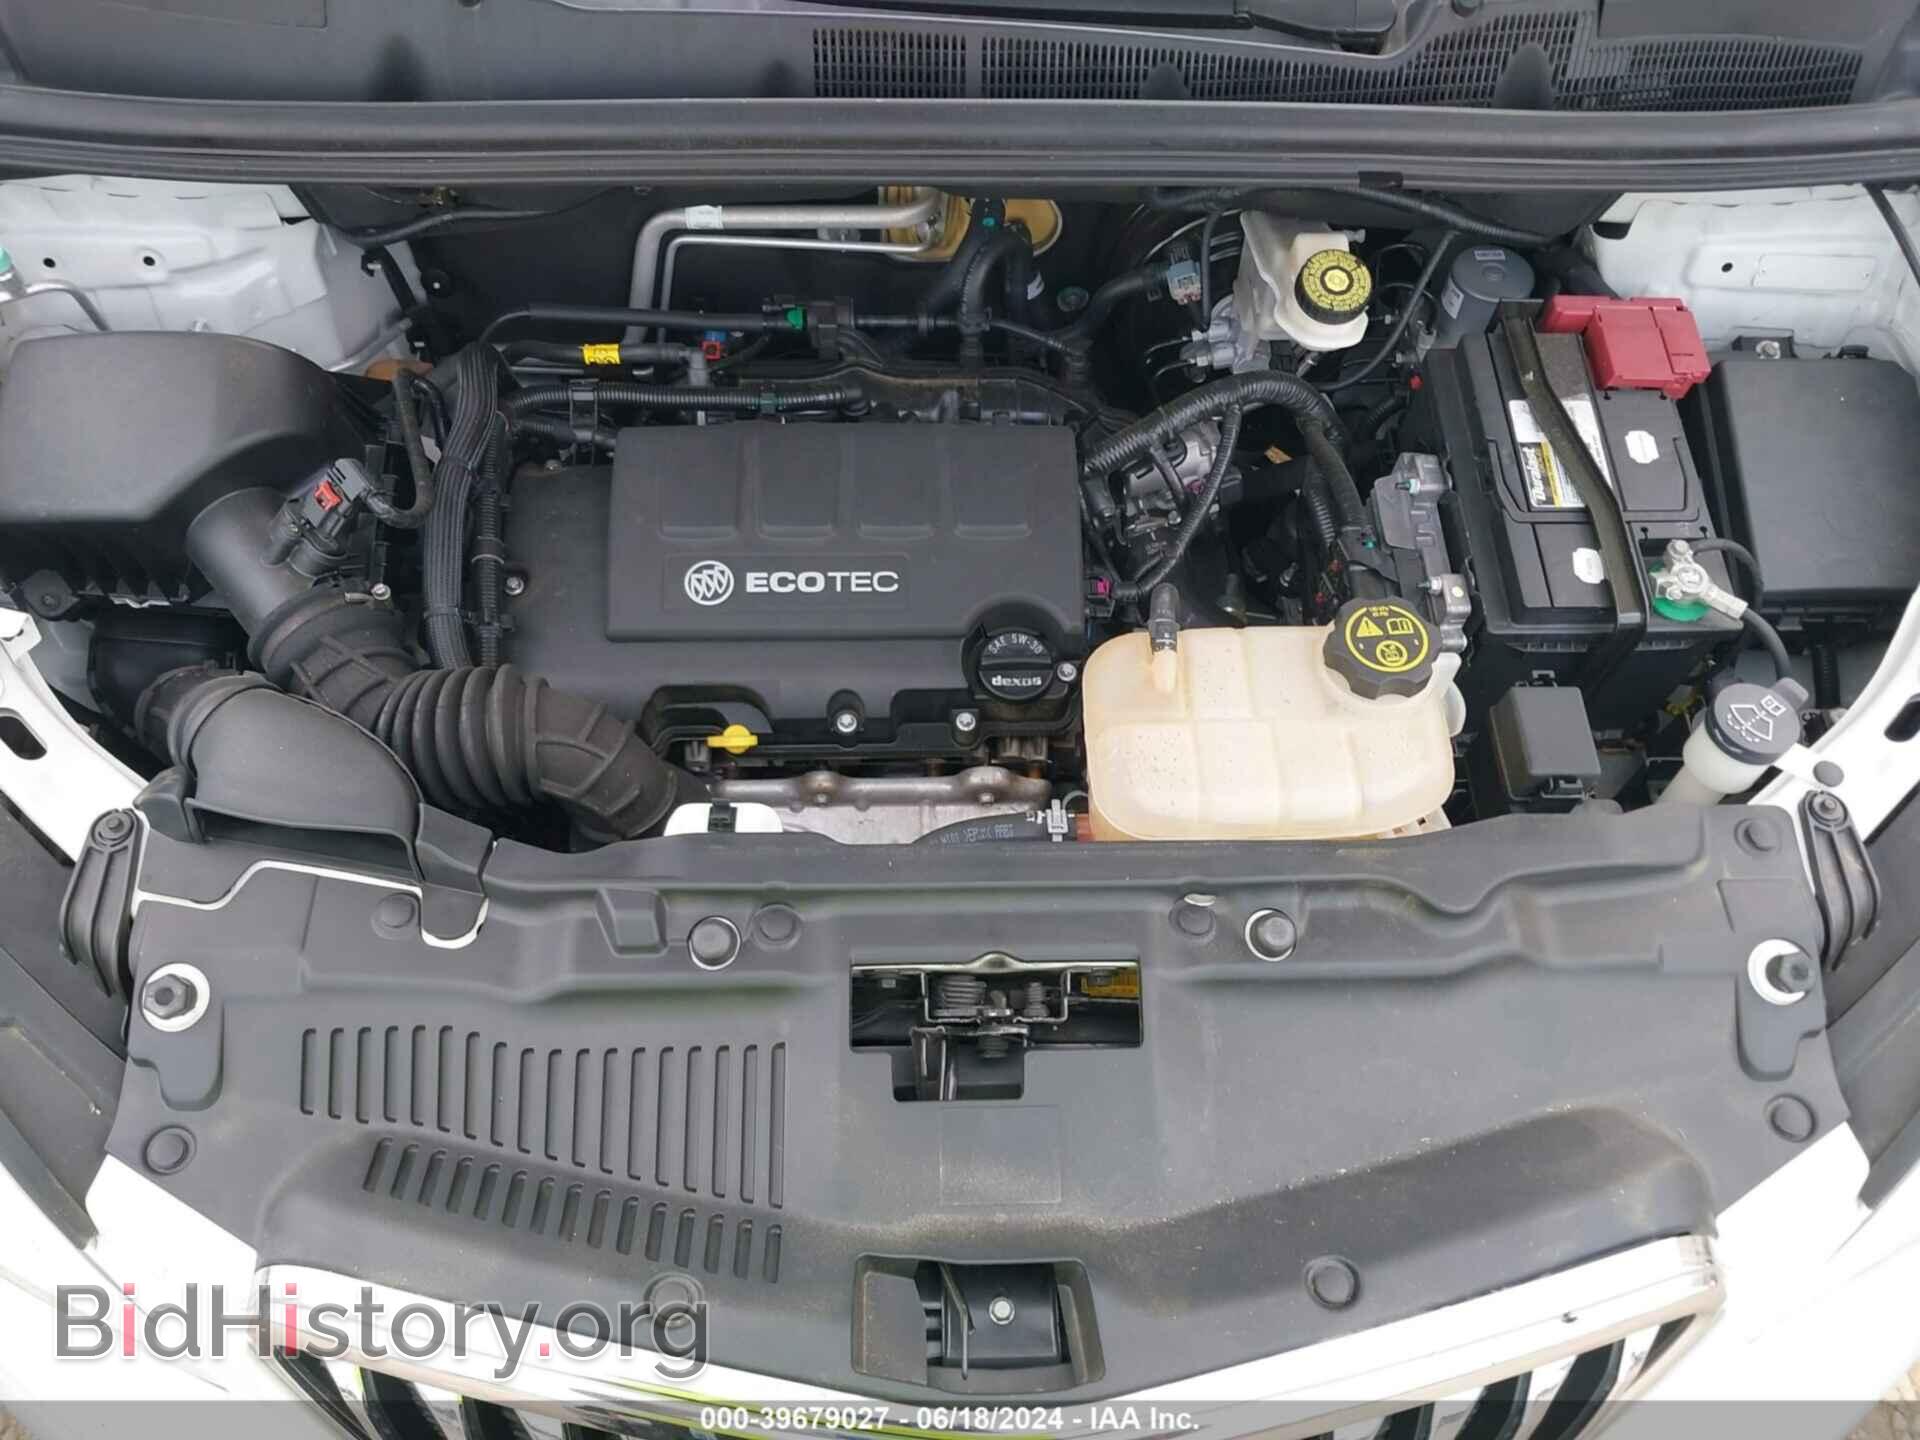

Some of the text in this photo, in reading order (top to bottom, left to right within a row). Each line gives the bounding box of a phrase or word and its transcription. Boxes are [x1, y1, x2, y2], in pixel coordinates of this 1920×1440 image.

[746, 571, 899, 593] ECOTEC
[988, 633, 1044, 655] SAE 5W-30
[991, 675, 1042, 687] dexos
